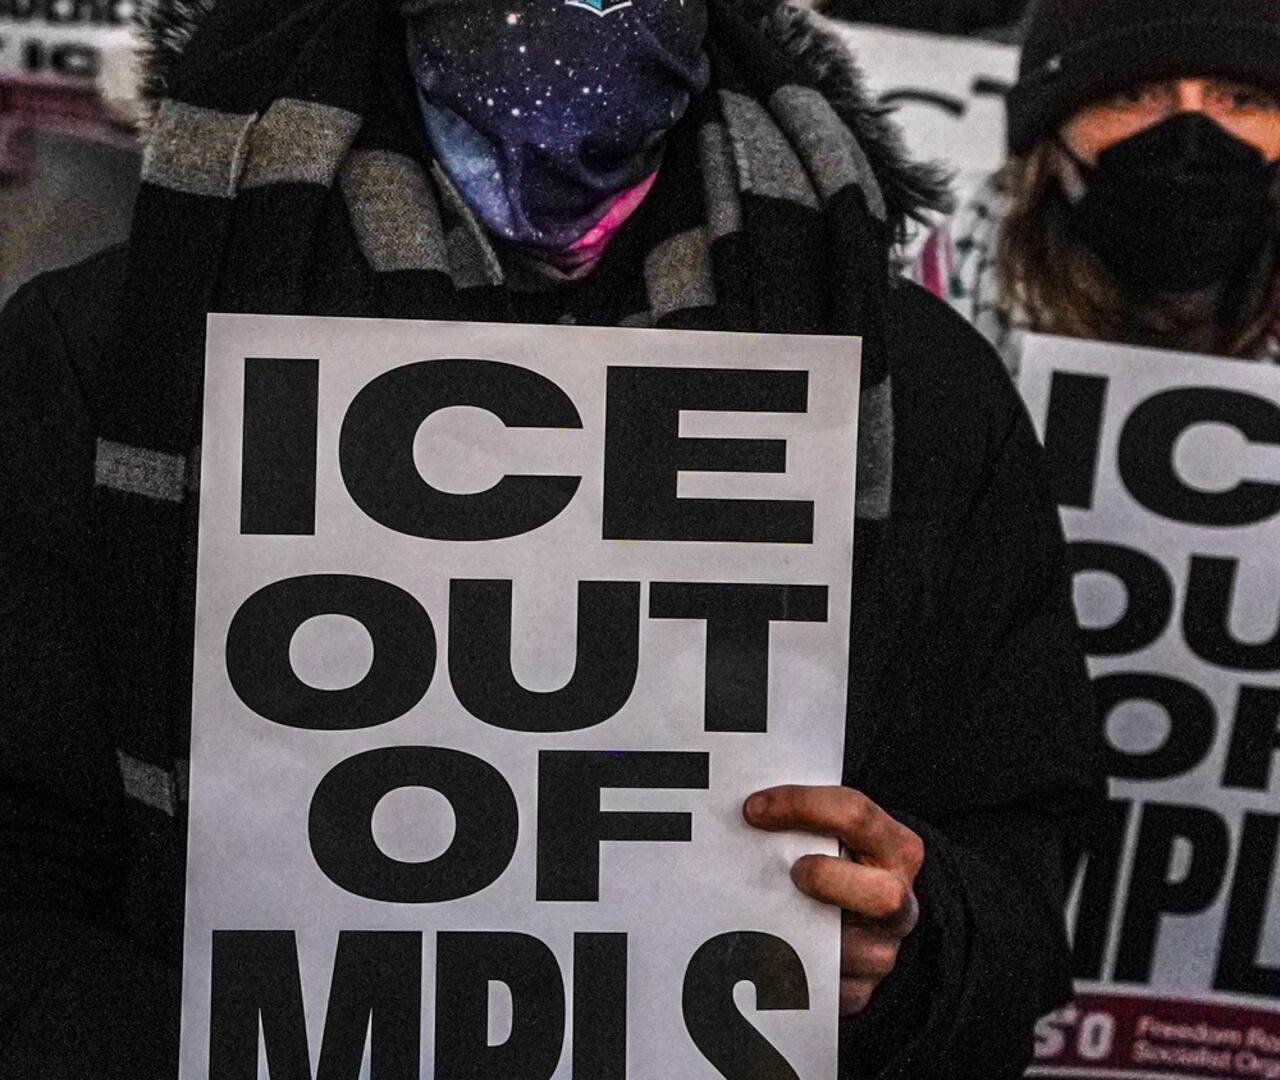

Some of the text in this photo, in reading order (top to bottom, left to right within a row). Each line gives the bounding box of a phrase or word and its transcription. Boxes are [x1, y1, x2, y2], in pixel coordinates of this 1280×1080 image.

[23, 37, 100, 77] IC
[239, 356, 816, 545] ICE
[224, 572, 830, 735] OUT
[307, 745, 711, 905] OF
